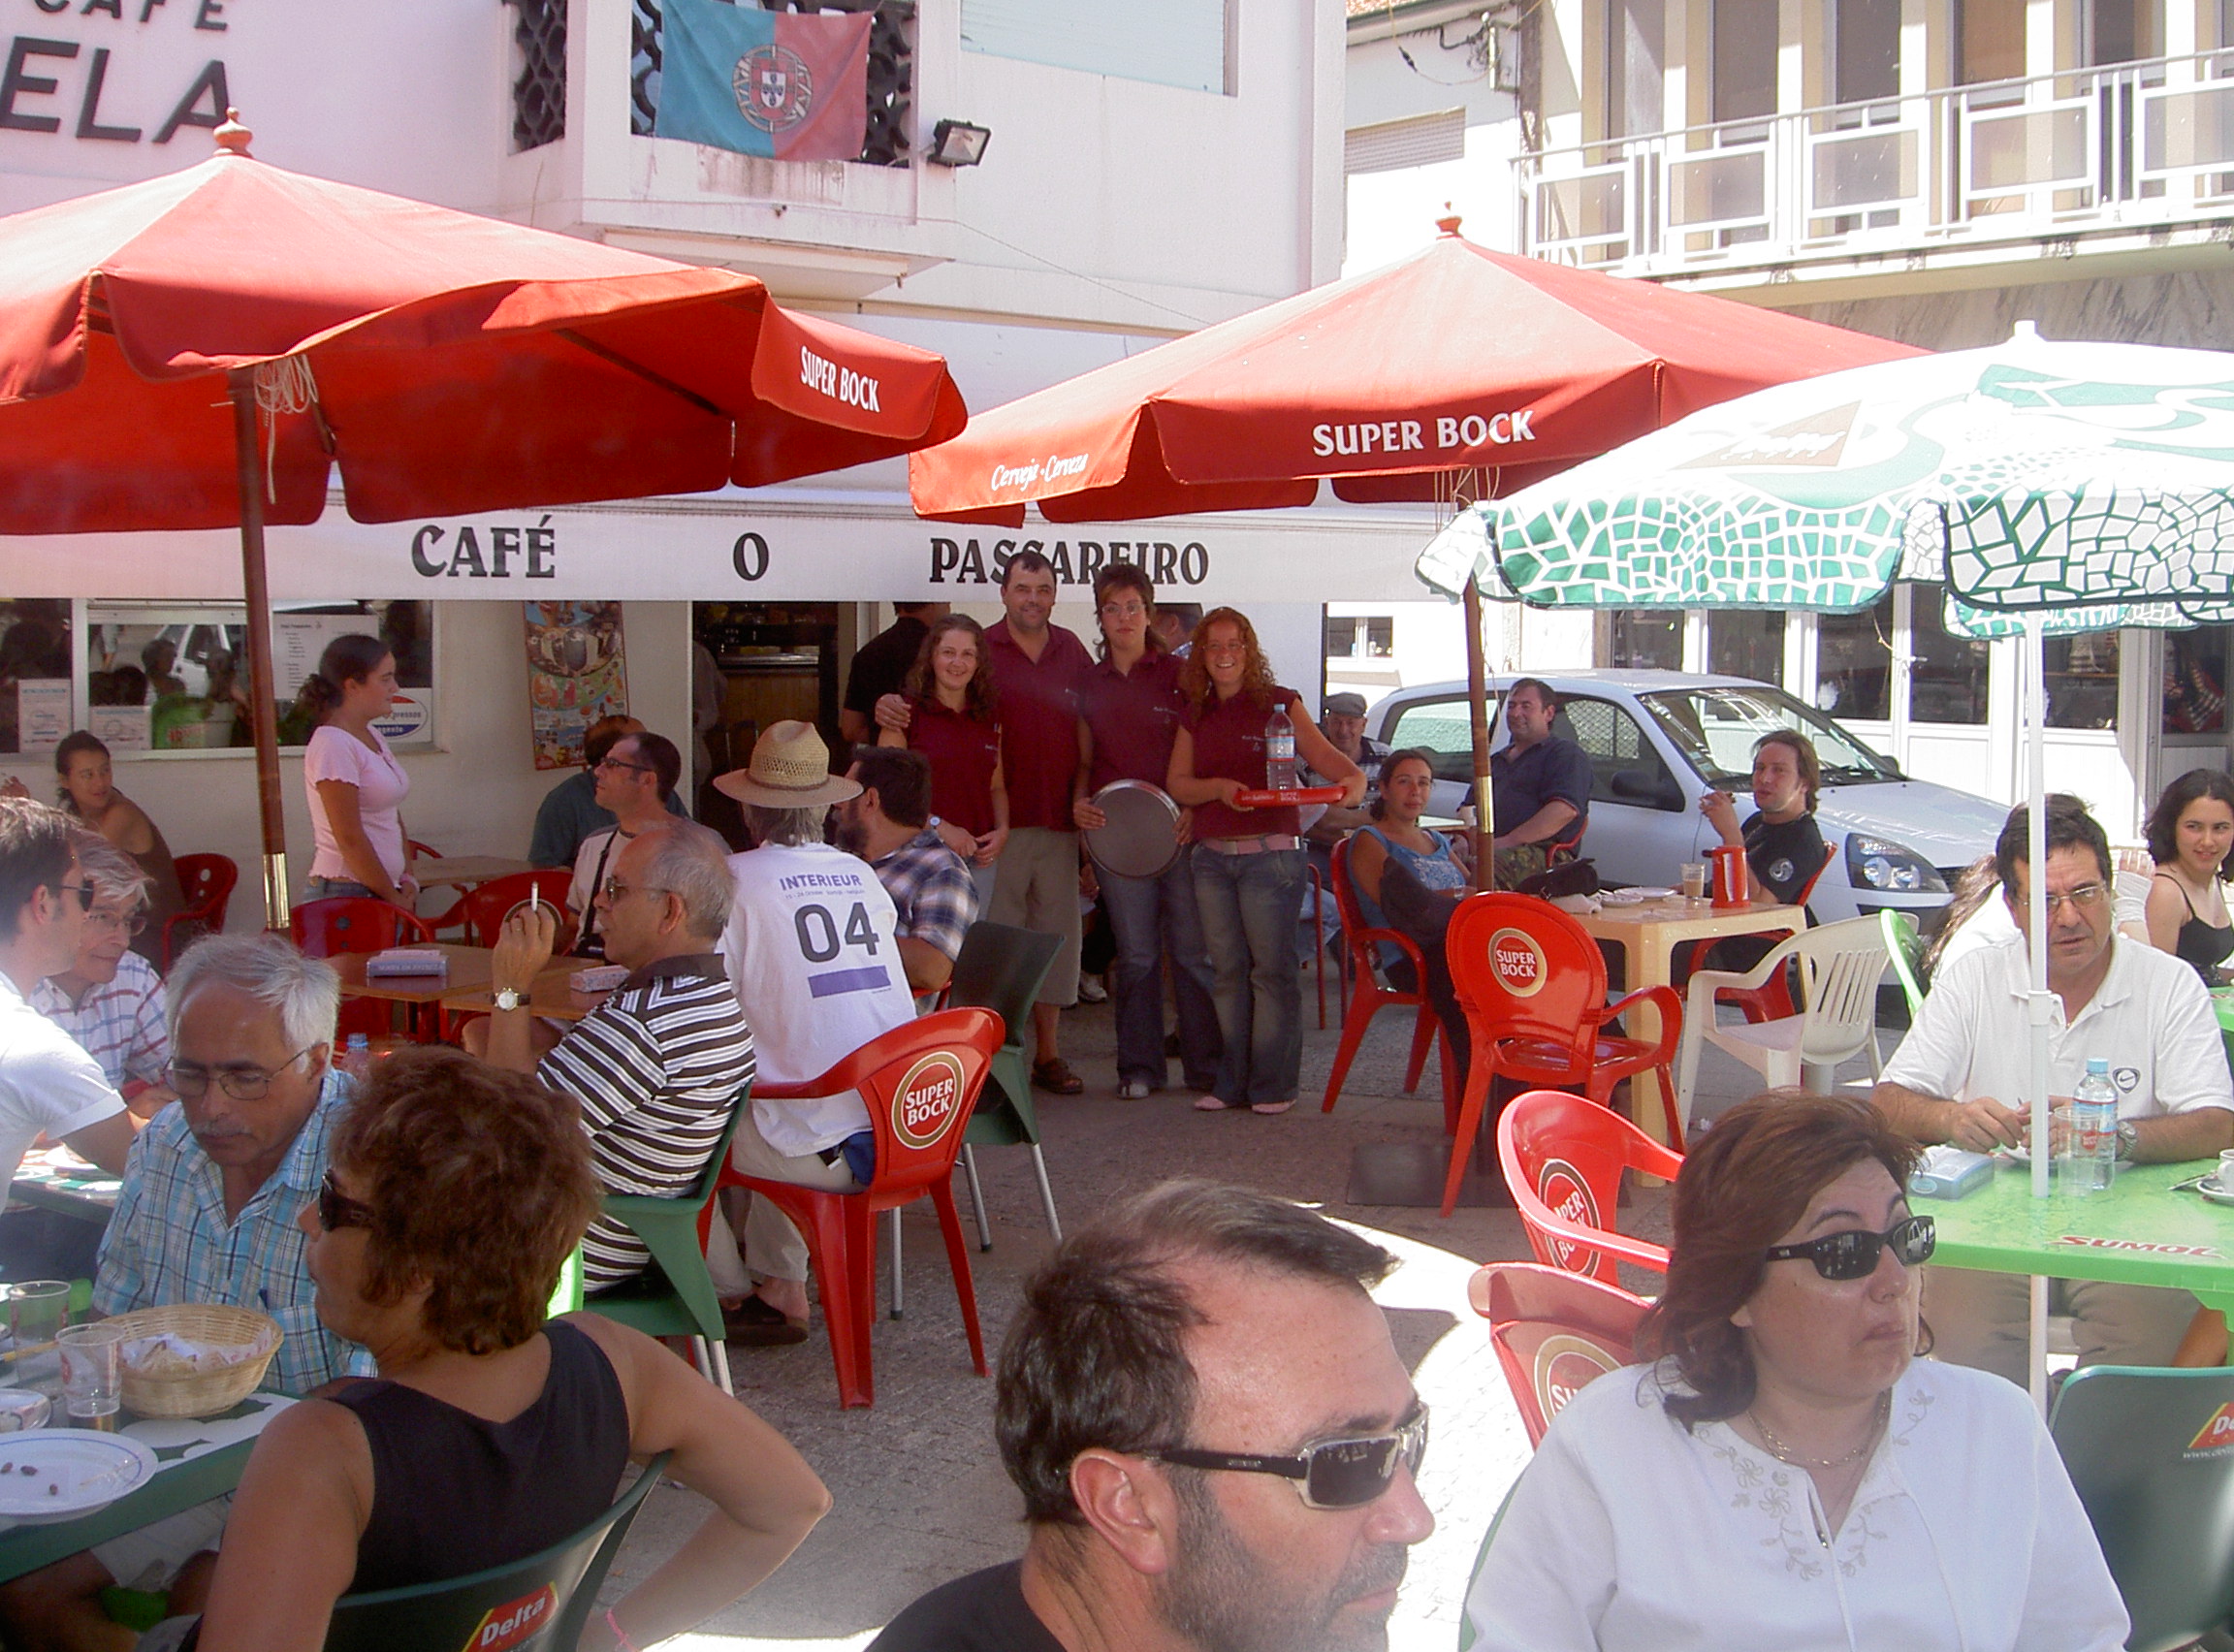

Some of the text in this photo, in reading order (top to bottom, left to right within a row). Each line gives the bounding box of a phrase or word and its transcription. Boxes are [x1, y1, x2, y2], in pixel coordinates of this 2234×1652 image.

[801, 345, 880, 413] SUPER BOCK
[1312, 409, 1536, 457] SUPER BOCK
[411, 514, 556, 579] CAFÉ
[732, 531, 770, 582] O
[780, 874, 862, 891] INTERIEUR
[794, 902, 880, 964] 04
[1496, 949, 1536, 966] SUPER
[1500, 963, 1536, 977] BOCK
[905, 1078, 954, 1110] SUPER
[908, 1095, 950, 1127] BOCK
[1553, 1191, 1585, 1221] PER
[2047, 1235, 2227, 1259] SUMOL
[480, 1596, 546, 1647] Delta
